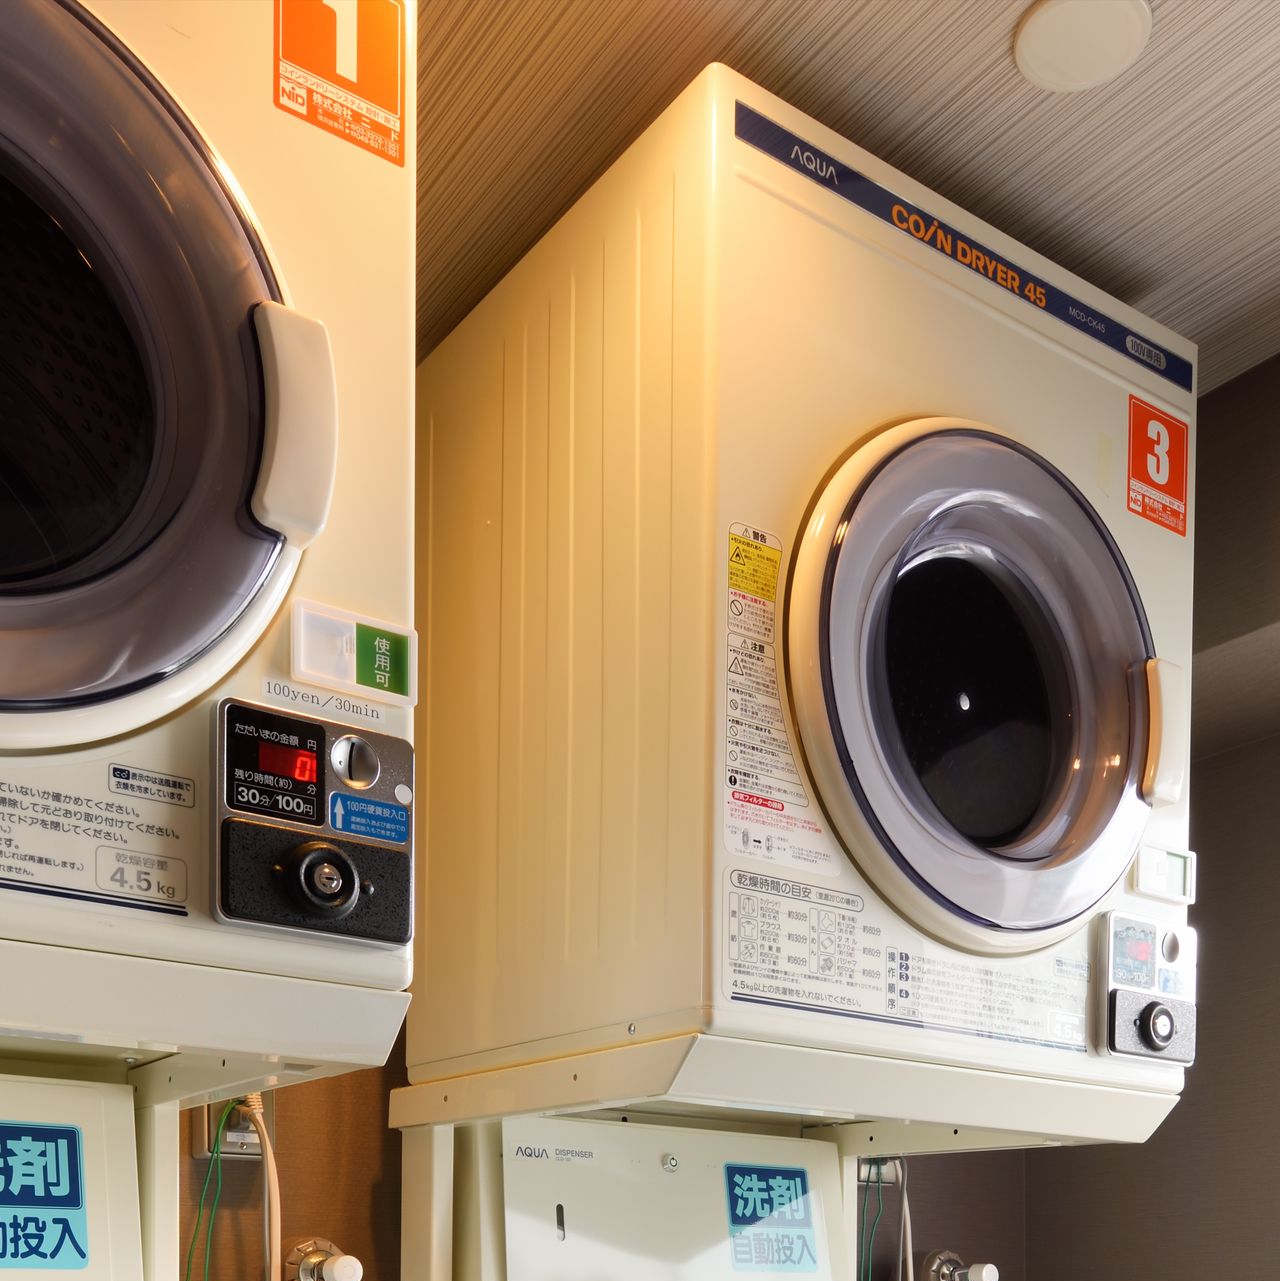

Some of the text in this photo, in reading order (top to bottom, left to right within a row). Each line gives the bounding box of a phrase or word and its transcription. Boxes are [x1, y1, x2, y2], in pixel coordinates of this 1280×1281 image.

[790, 144, 840, 185] AQUA
[956, 238, 1022, 295] DRYER
[1024, 281, 1047, 309] 45
[1146, 419, 1170, 485] 3
[374, 636, 391, 688] 使用可
[234, 722, 317, 751] ただいまの金額 円
[234, 767, 317, 796] 残り時間(約) 分
[237, 785, 314, 816] 30分/100円
[114, 852, 169, 872] 乾燥容量
[109, 866, 176, 899] 4.5 kg
[737, 873, 813, 900] 乾燥時間の目安
[515, 1146, 594, 1160] AQUA DISPENSER
[733, 1174, 803, 1221] 洗剤
[732, 1231, 817, 1266] 自動投入
